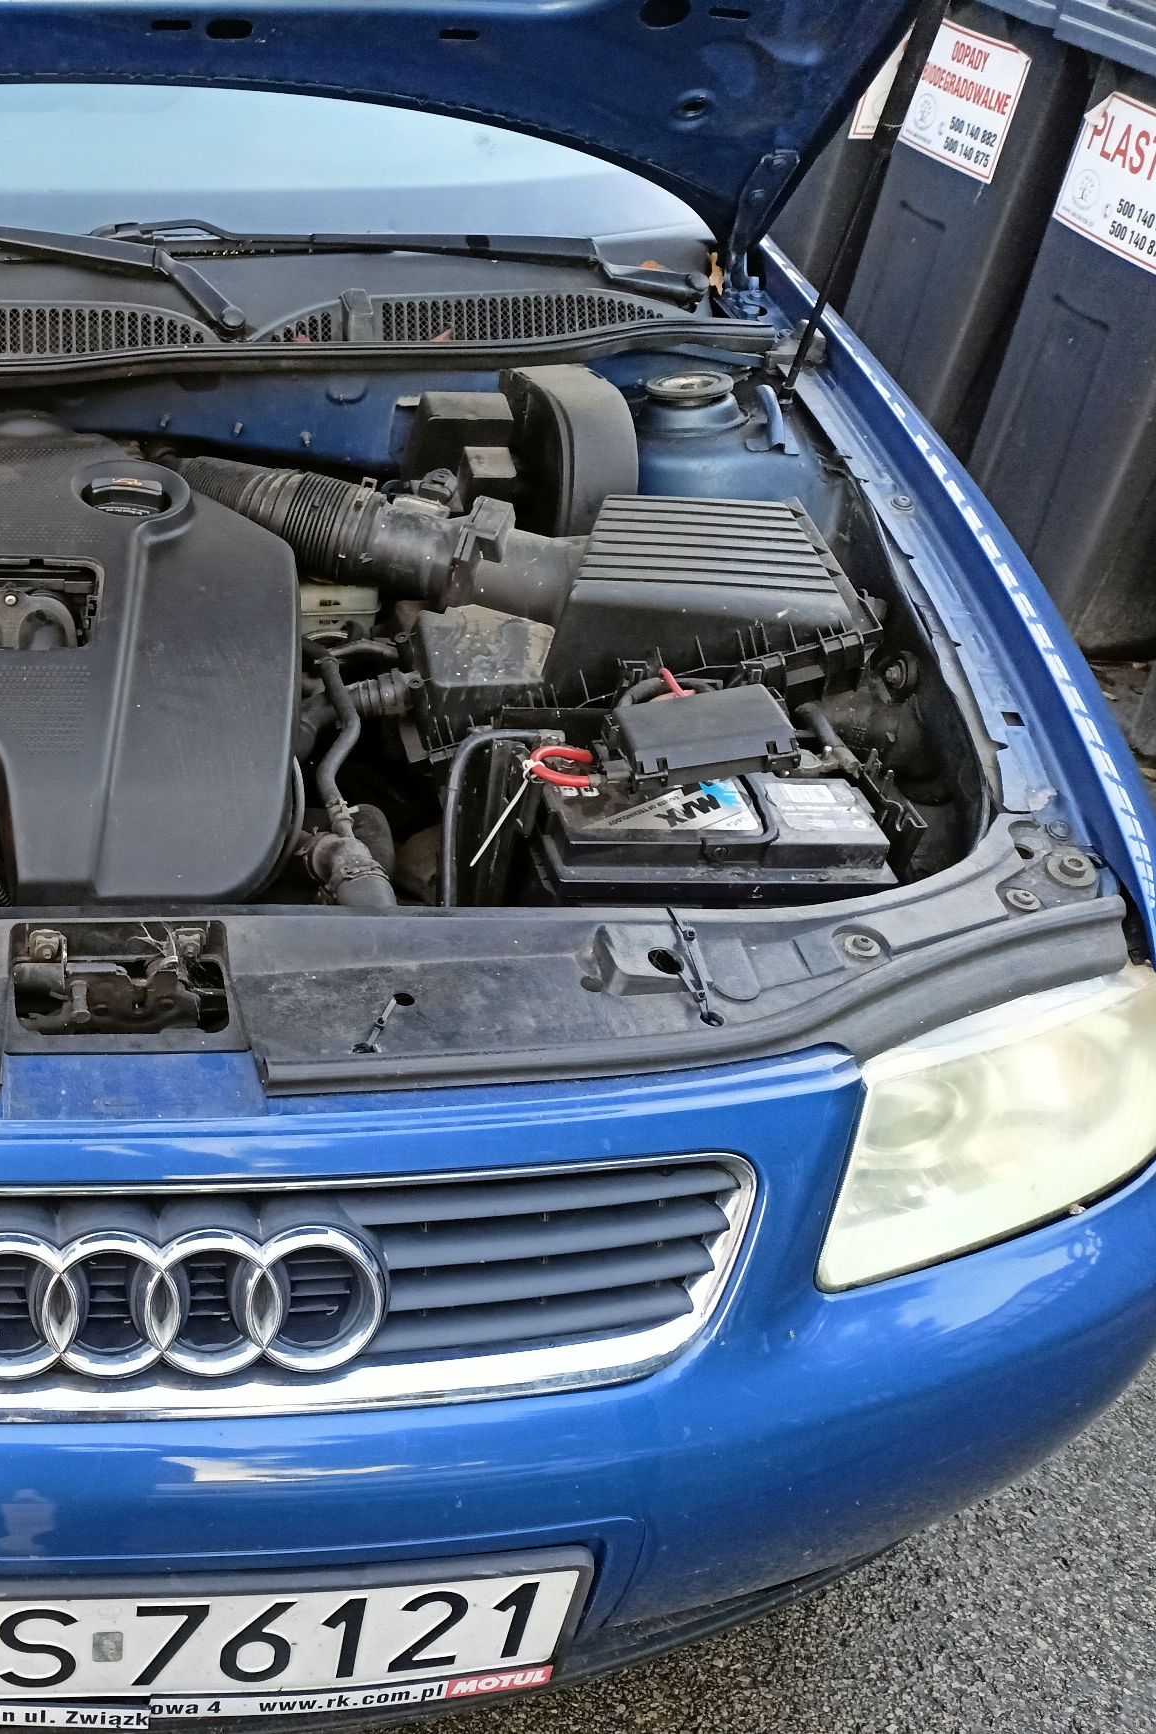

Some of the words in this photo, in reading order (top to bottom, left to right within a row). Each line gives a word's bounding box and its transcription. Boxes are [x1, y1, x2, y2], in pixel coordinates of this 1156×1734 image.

[951, 41, 990, 72] ODPADY
[922, 62, 1012, 115] BIODEGRADOWALNE
[949, 116, 965, 134] 500
[966, 123, 980, 141] 140
[980, 129, 998, 148] 882
[943, 136, 959, 154] 500
[959, 143, 974, 161] 140
[974, 150, 990, 168] 875
[1116, 198, 1136, 219] 500
[1136, 208, 1156, 229] 140
[1109, 220, 1128, 241] 500
[1128, 230, 1147, 251] 140
[1147, 239, 1156, 258] 8
[654, 793, 722, 828] MAX
[131, 1581, 541, 1686] 76121
[206, 1700, 222, 1714] 4
[259, 1683, 444, 1713] www.rk.com.pl
[451, 1669, 547, 1696] MOTUL
[25, 1709, 56, 1724] ul.
[66, 1710, 149, 1728] Związk
